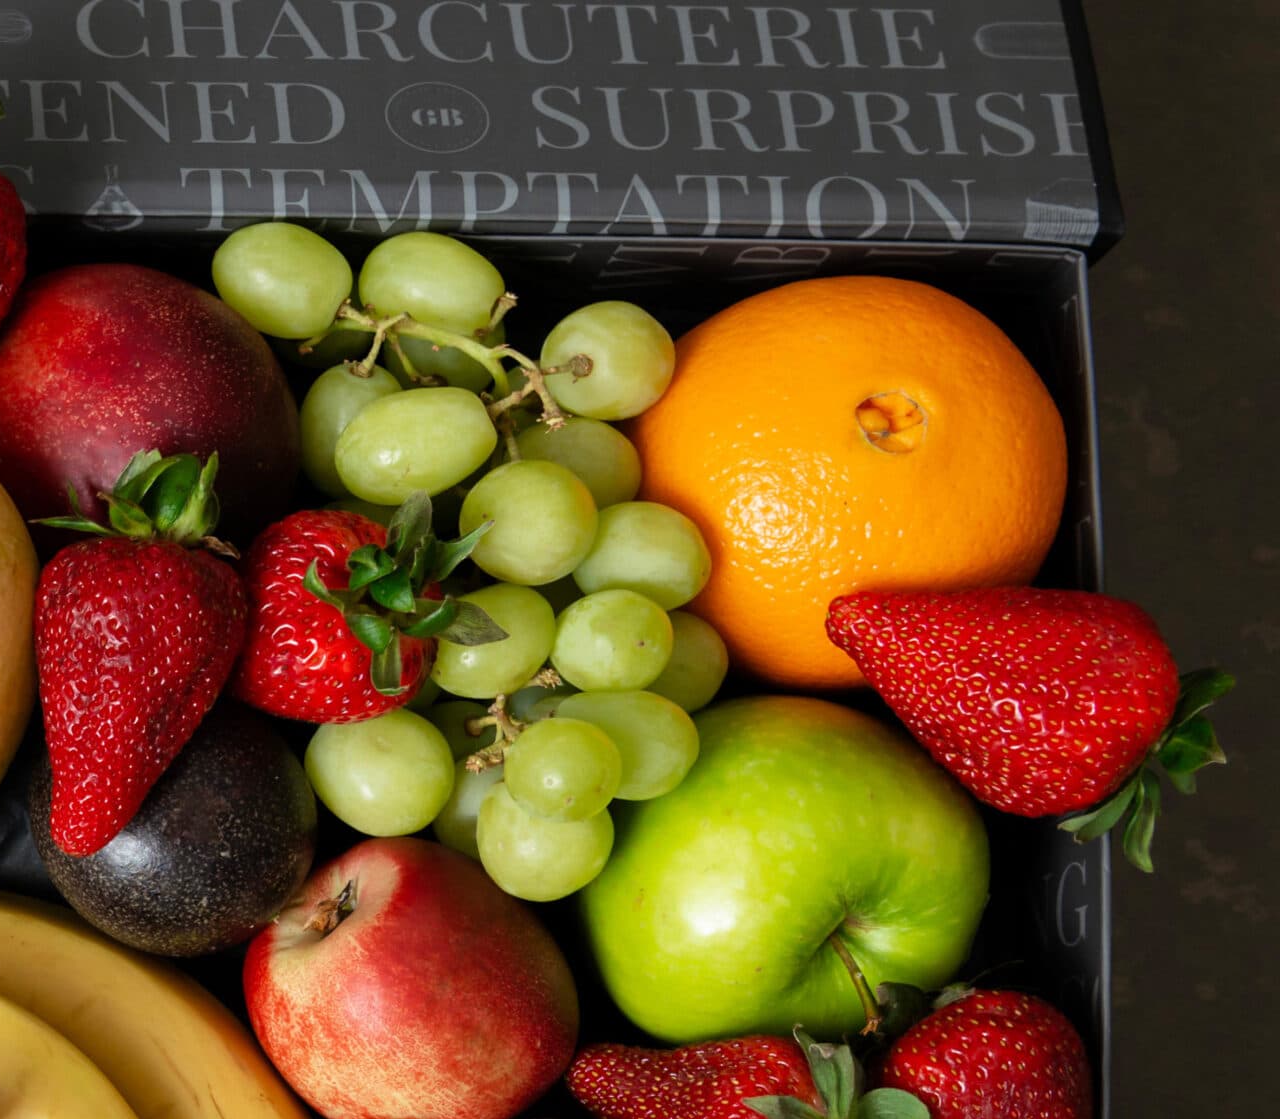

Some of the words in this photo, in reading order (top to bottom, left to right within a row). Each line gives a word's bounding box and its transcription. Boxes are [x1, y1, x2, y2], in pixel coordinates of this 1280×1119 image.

[76, 0, 946, 69] CHARCUTERIE
[411, 108, 464, 127] GB
[531, 85, 1089, 157] SURPRISE
[180, 168, 976, 241] TEMPTATION
